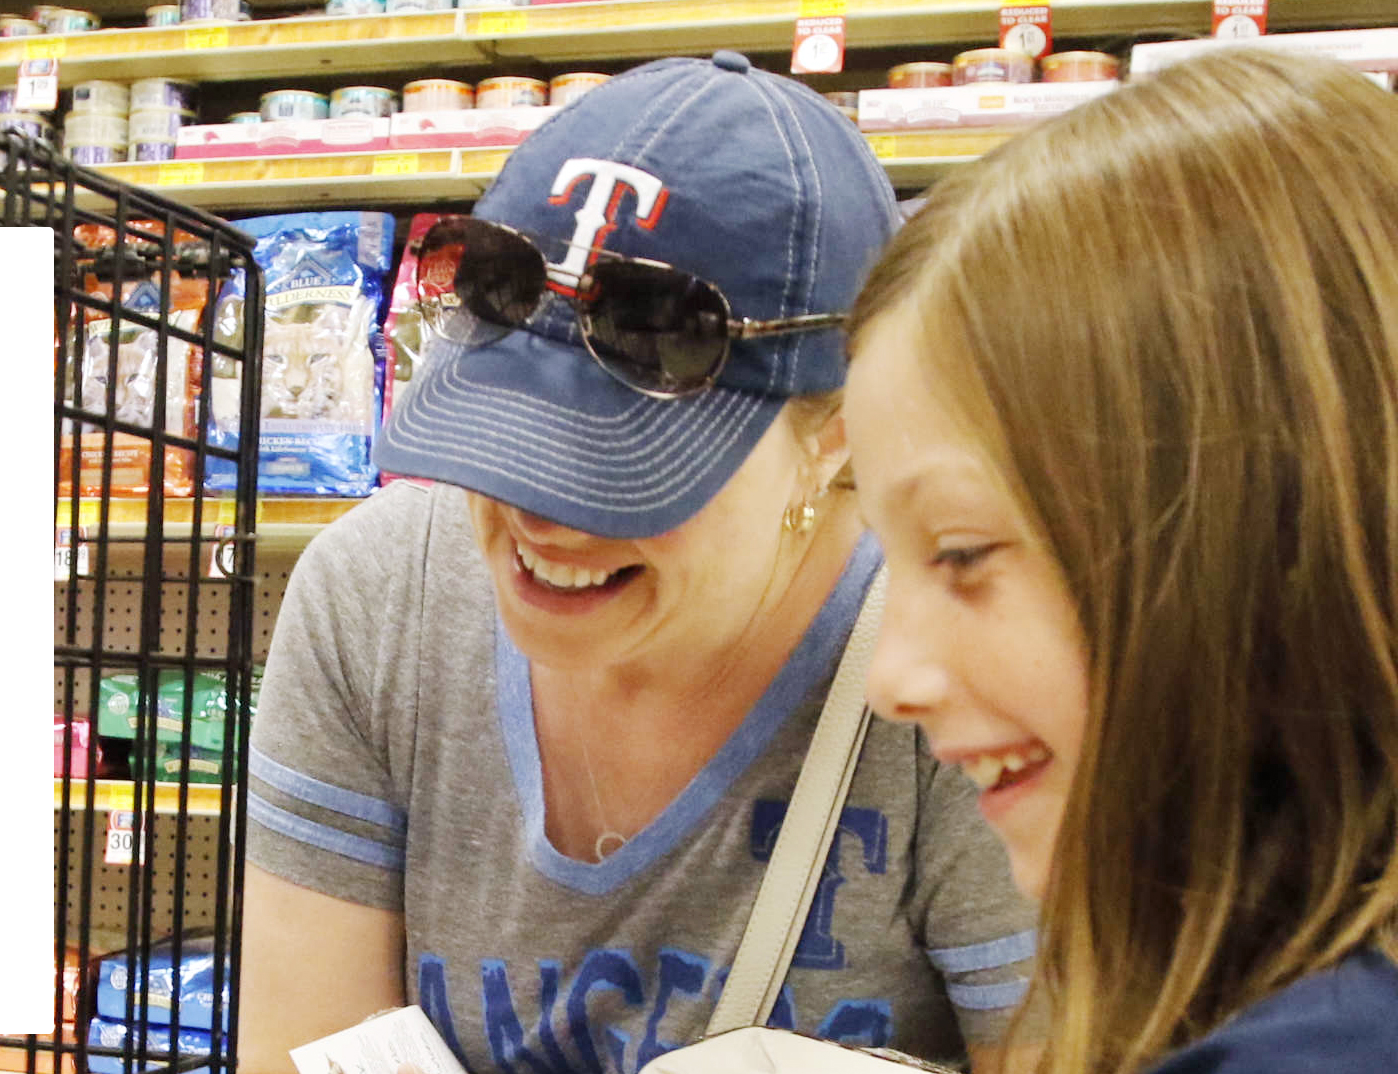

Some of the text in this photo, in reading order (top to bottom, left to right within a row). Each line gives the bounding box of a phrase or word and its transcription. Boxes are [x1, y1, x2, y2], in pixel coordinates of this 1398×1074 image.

[290, 277, 322, 289] BLUE
[546, 158, 671, 301] T
[750, 799, 889, 971] T
